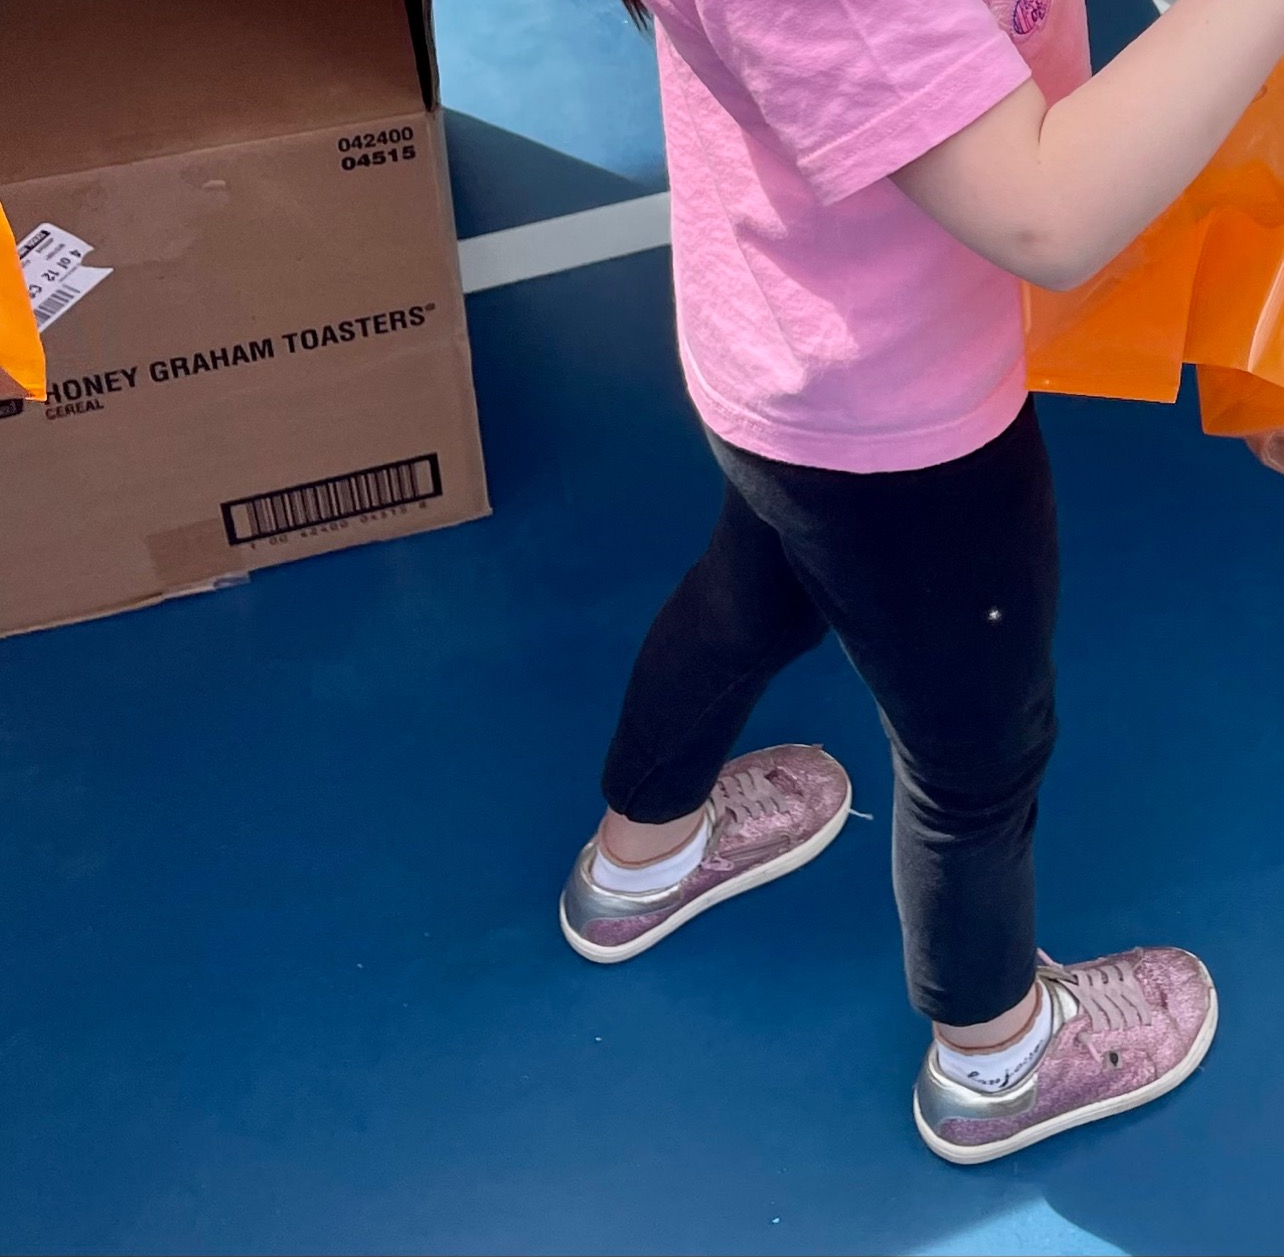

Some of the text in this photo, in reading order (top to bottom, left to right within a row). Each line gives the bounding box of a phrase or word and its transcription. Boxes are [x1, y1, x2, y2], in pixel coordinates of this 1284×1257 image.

[338, 127, 414, 153] 042400
[341, 145, 417, 171] 04515
[69, 249, 81, 258] 4
[41, 269, 59, 282] 12
[46, 366, 138, 404] HONEY
[151, 337, 275, 384] GRAHAM
[45, 398, 104, 420] CEREAL
